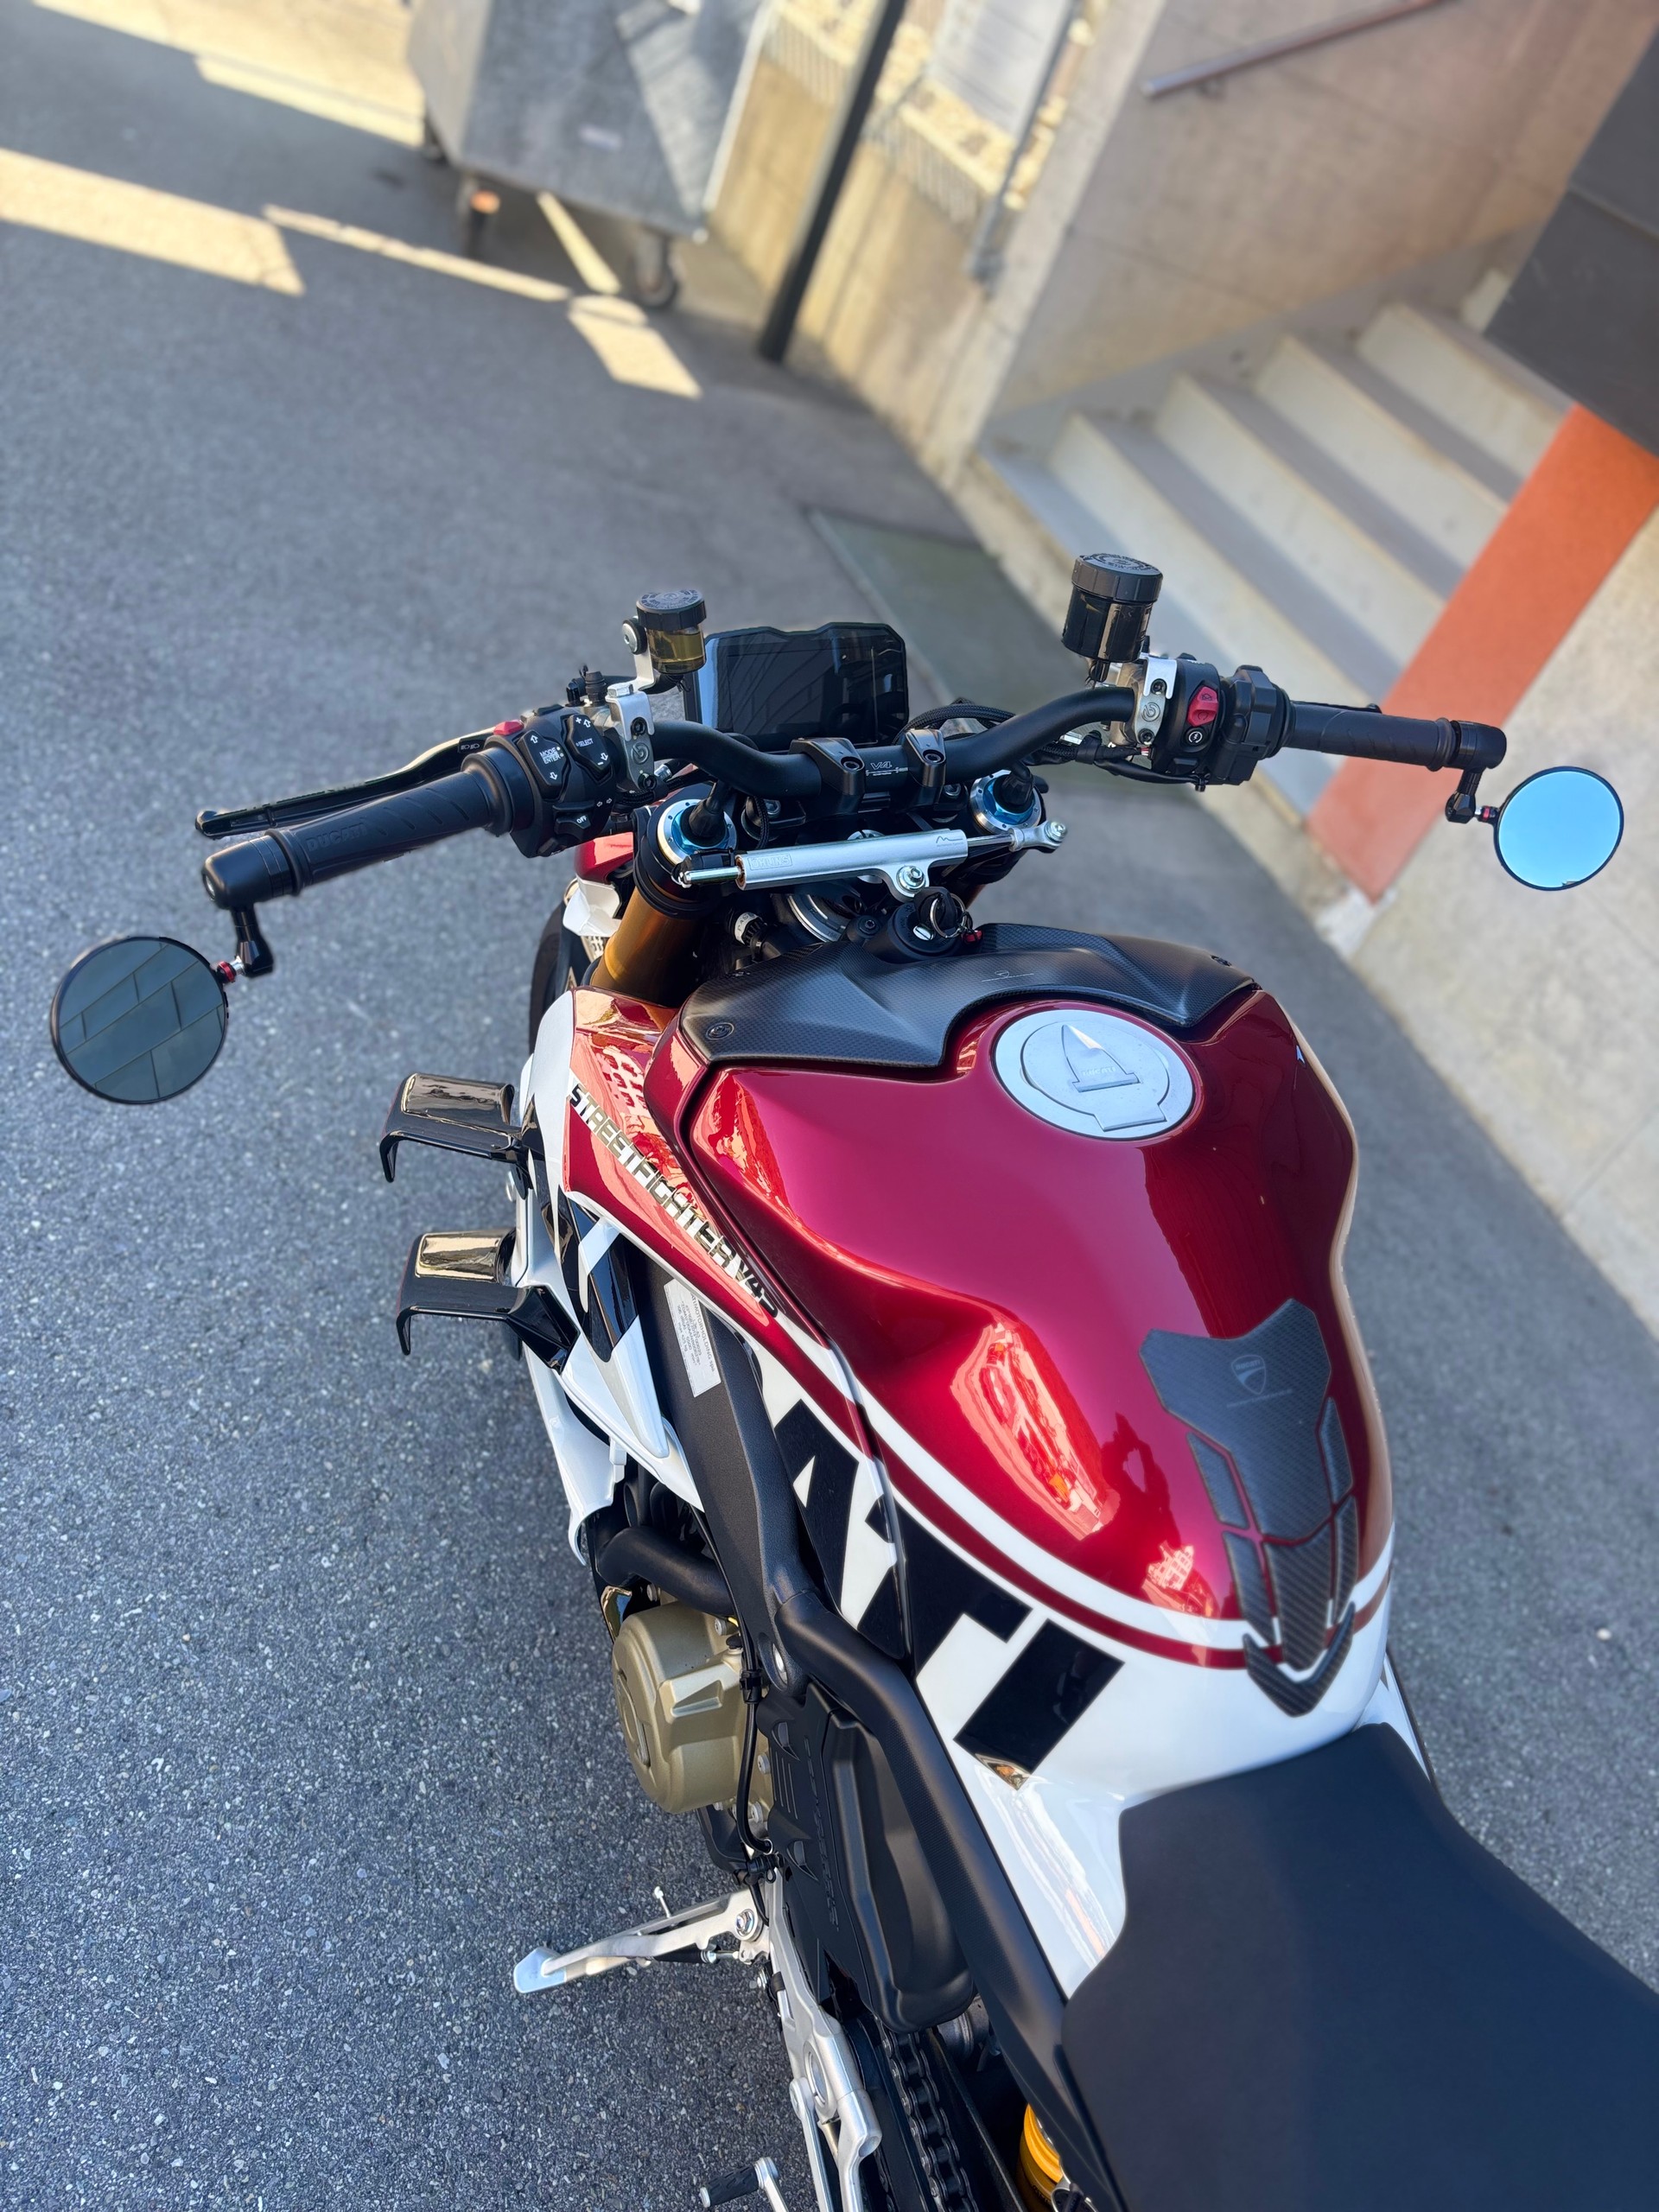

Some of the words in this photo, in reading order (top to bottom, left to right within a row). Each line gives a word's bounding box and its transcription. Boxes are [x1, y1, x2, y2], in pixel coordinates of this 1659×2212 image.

[539, 747, 556, 758] MODE
[542, 753, 561, 765] ENTER
[870, 760, 893, 770] V4
[576, 815, 588, 823] OFF
[305, 821, 368, 852] DUCATI
[569, 1084, 738, 1269] STREETFIGHTER
